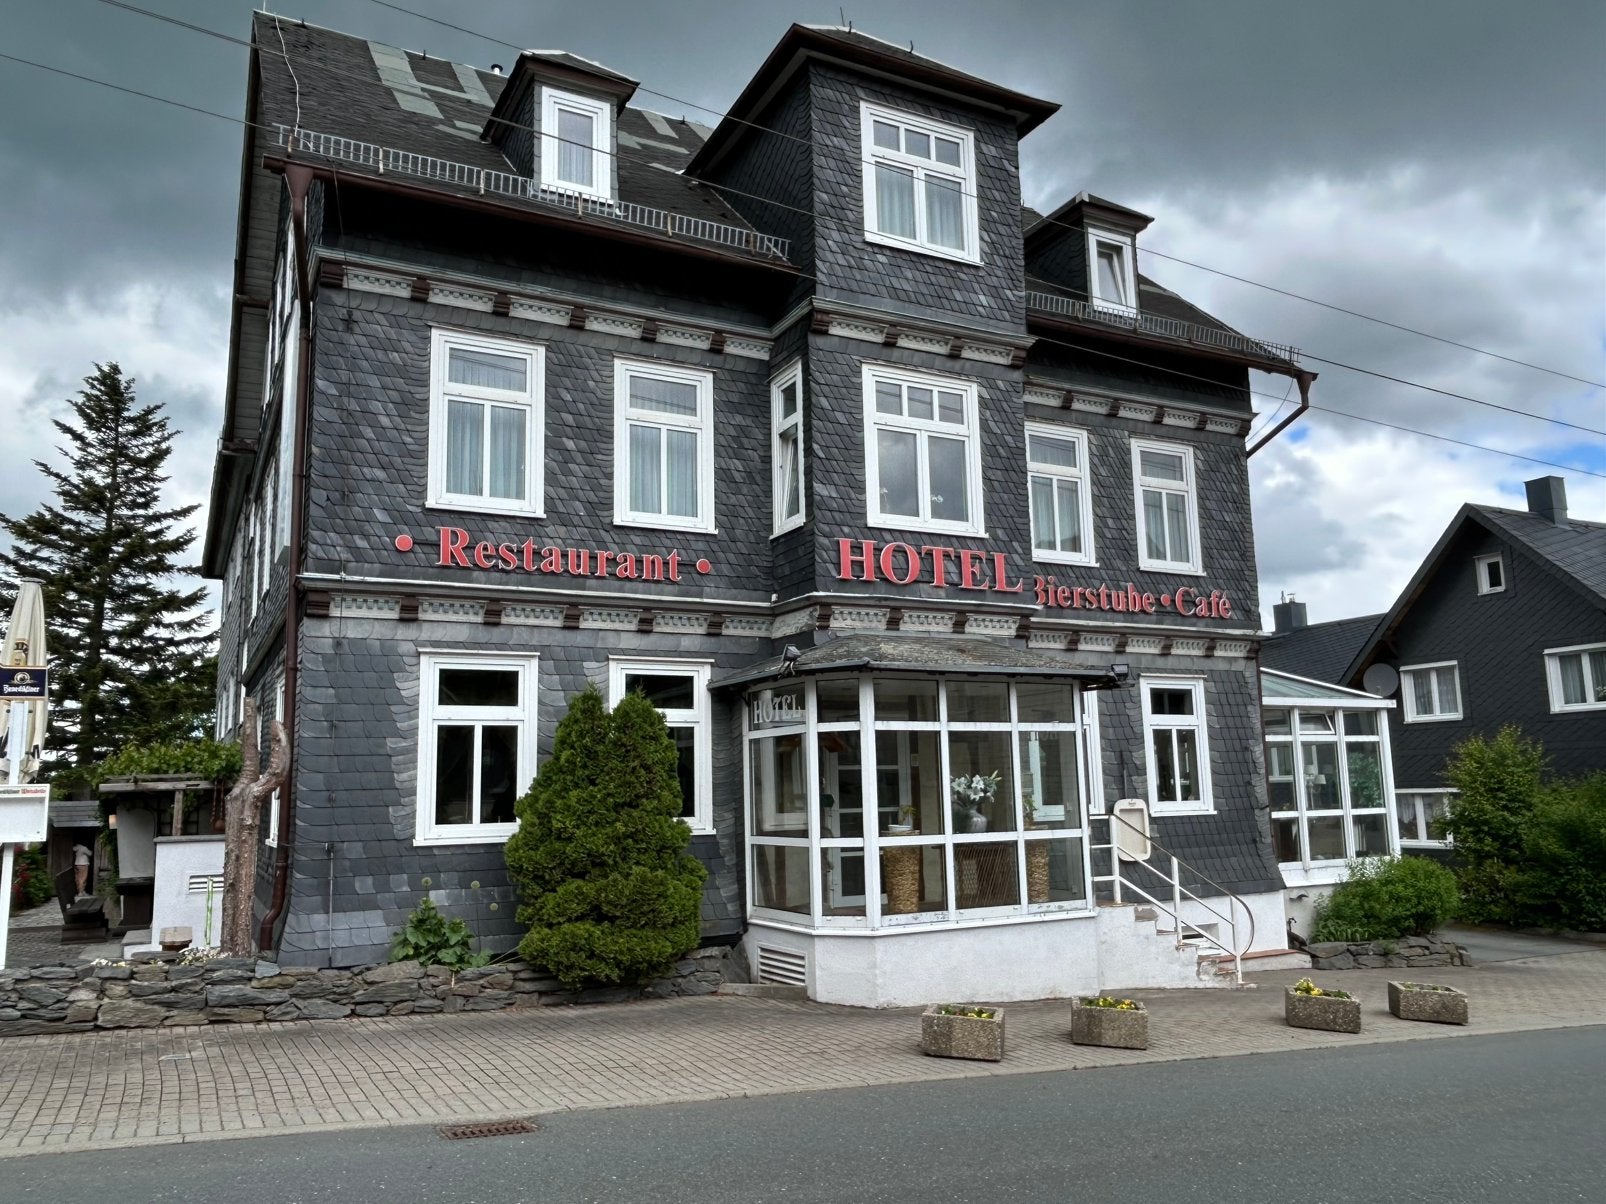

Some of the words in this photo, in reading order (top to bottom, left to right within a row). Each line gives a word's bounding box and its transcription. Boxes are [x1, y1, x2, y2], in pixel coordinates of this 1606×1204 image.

[435, 525, 682, 583] Restaurant
[834, 537, 1024, 593] HOTEL
[1175, 586, 1232, 620] Café
[753, 693, 801, 724] HOTEL
